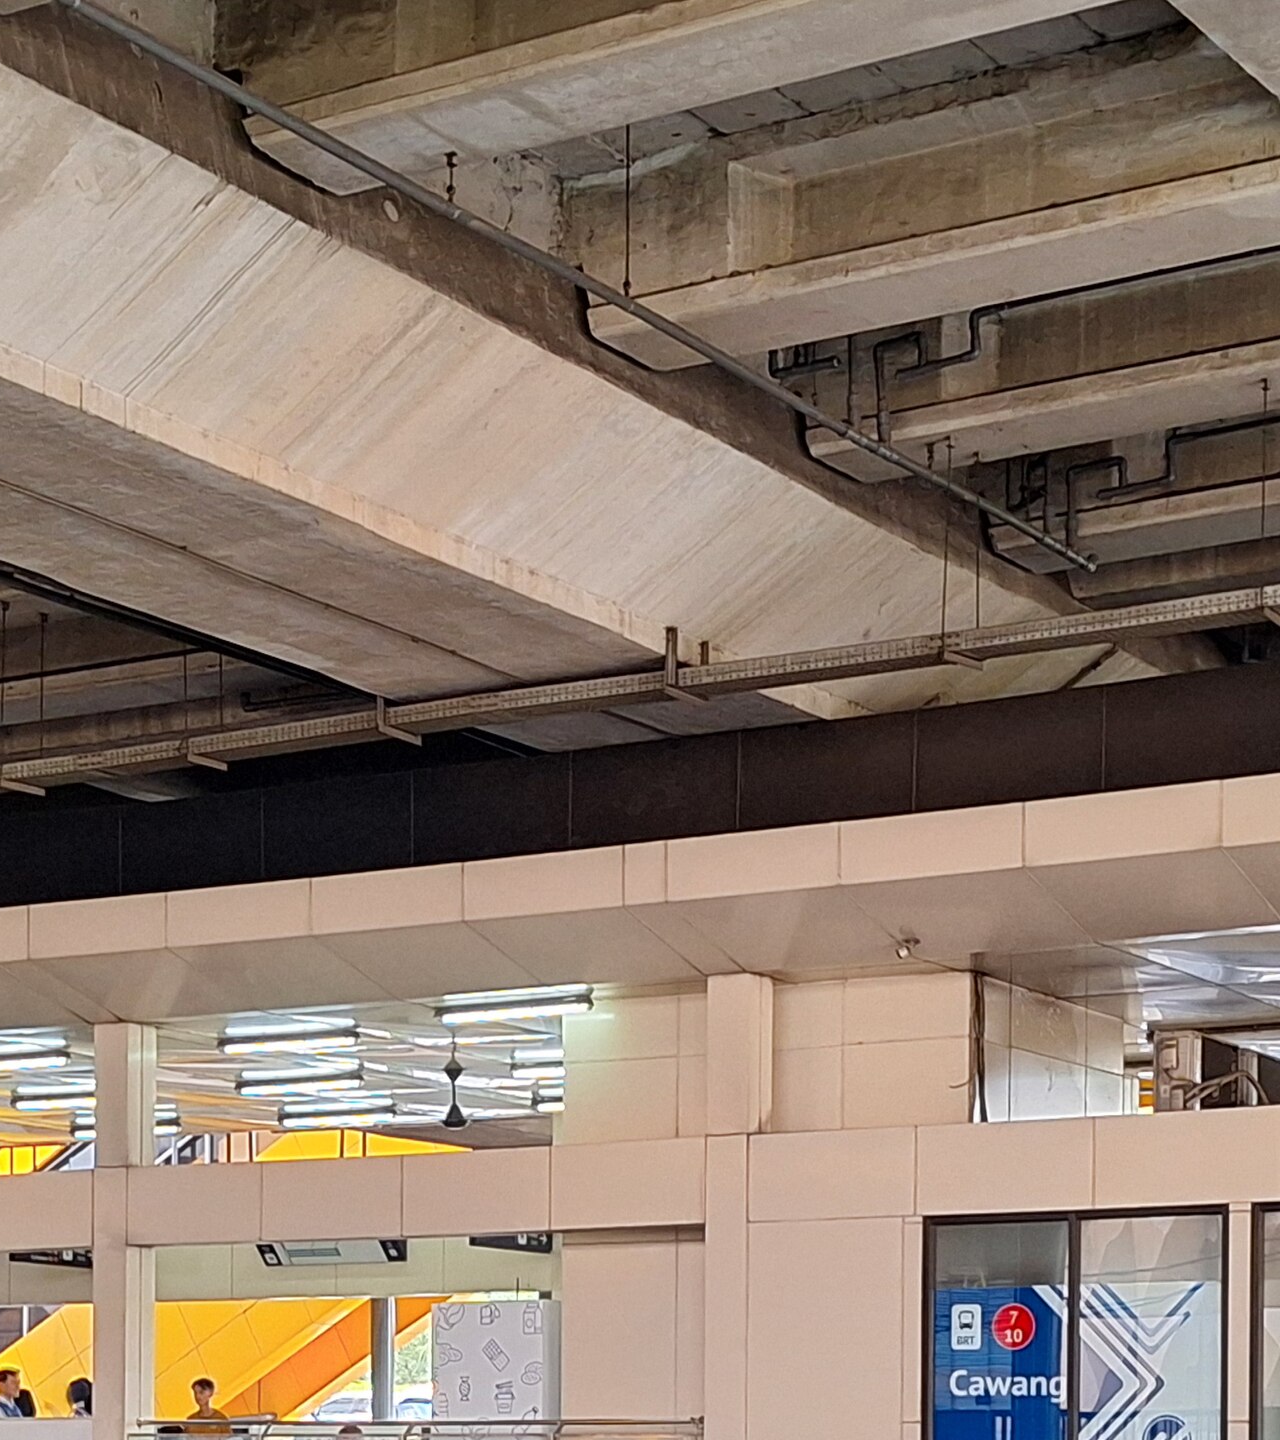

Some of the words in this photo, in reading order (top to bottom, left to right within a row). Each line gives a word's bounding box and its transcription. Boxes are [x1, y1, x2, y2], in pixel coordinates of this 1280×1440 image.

[1008, 1310, 1019, 1326] 7
[956, 1335, 976, 1346] BRT
[1004, 1328, 1023, 1343] 10
[949, 1369, 1067, 1404] Cawang
